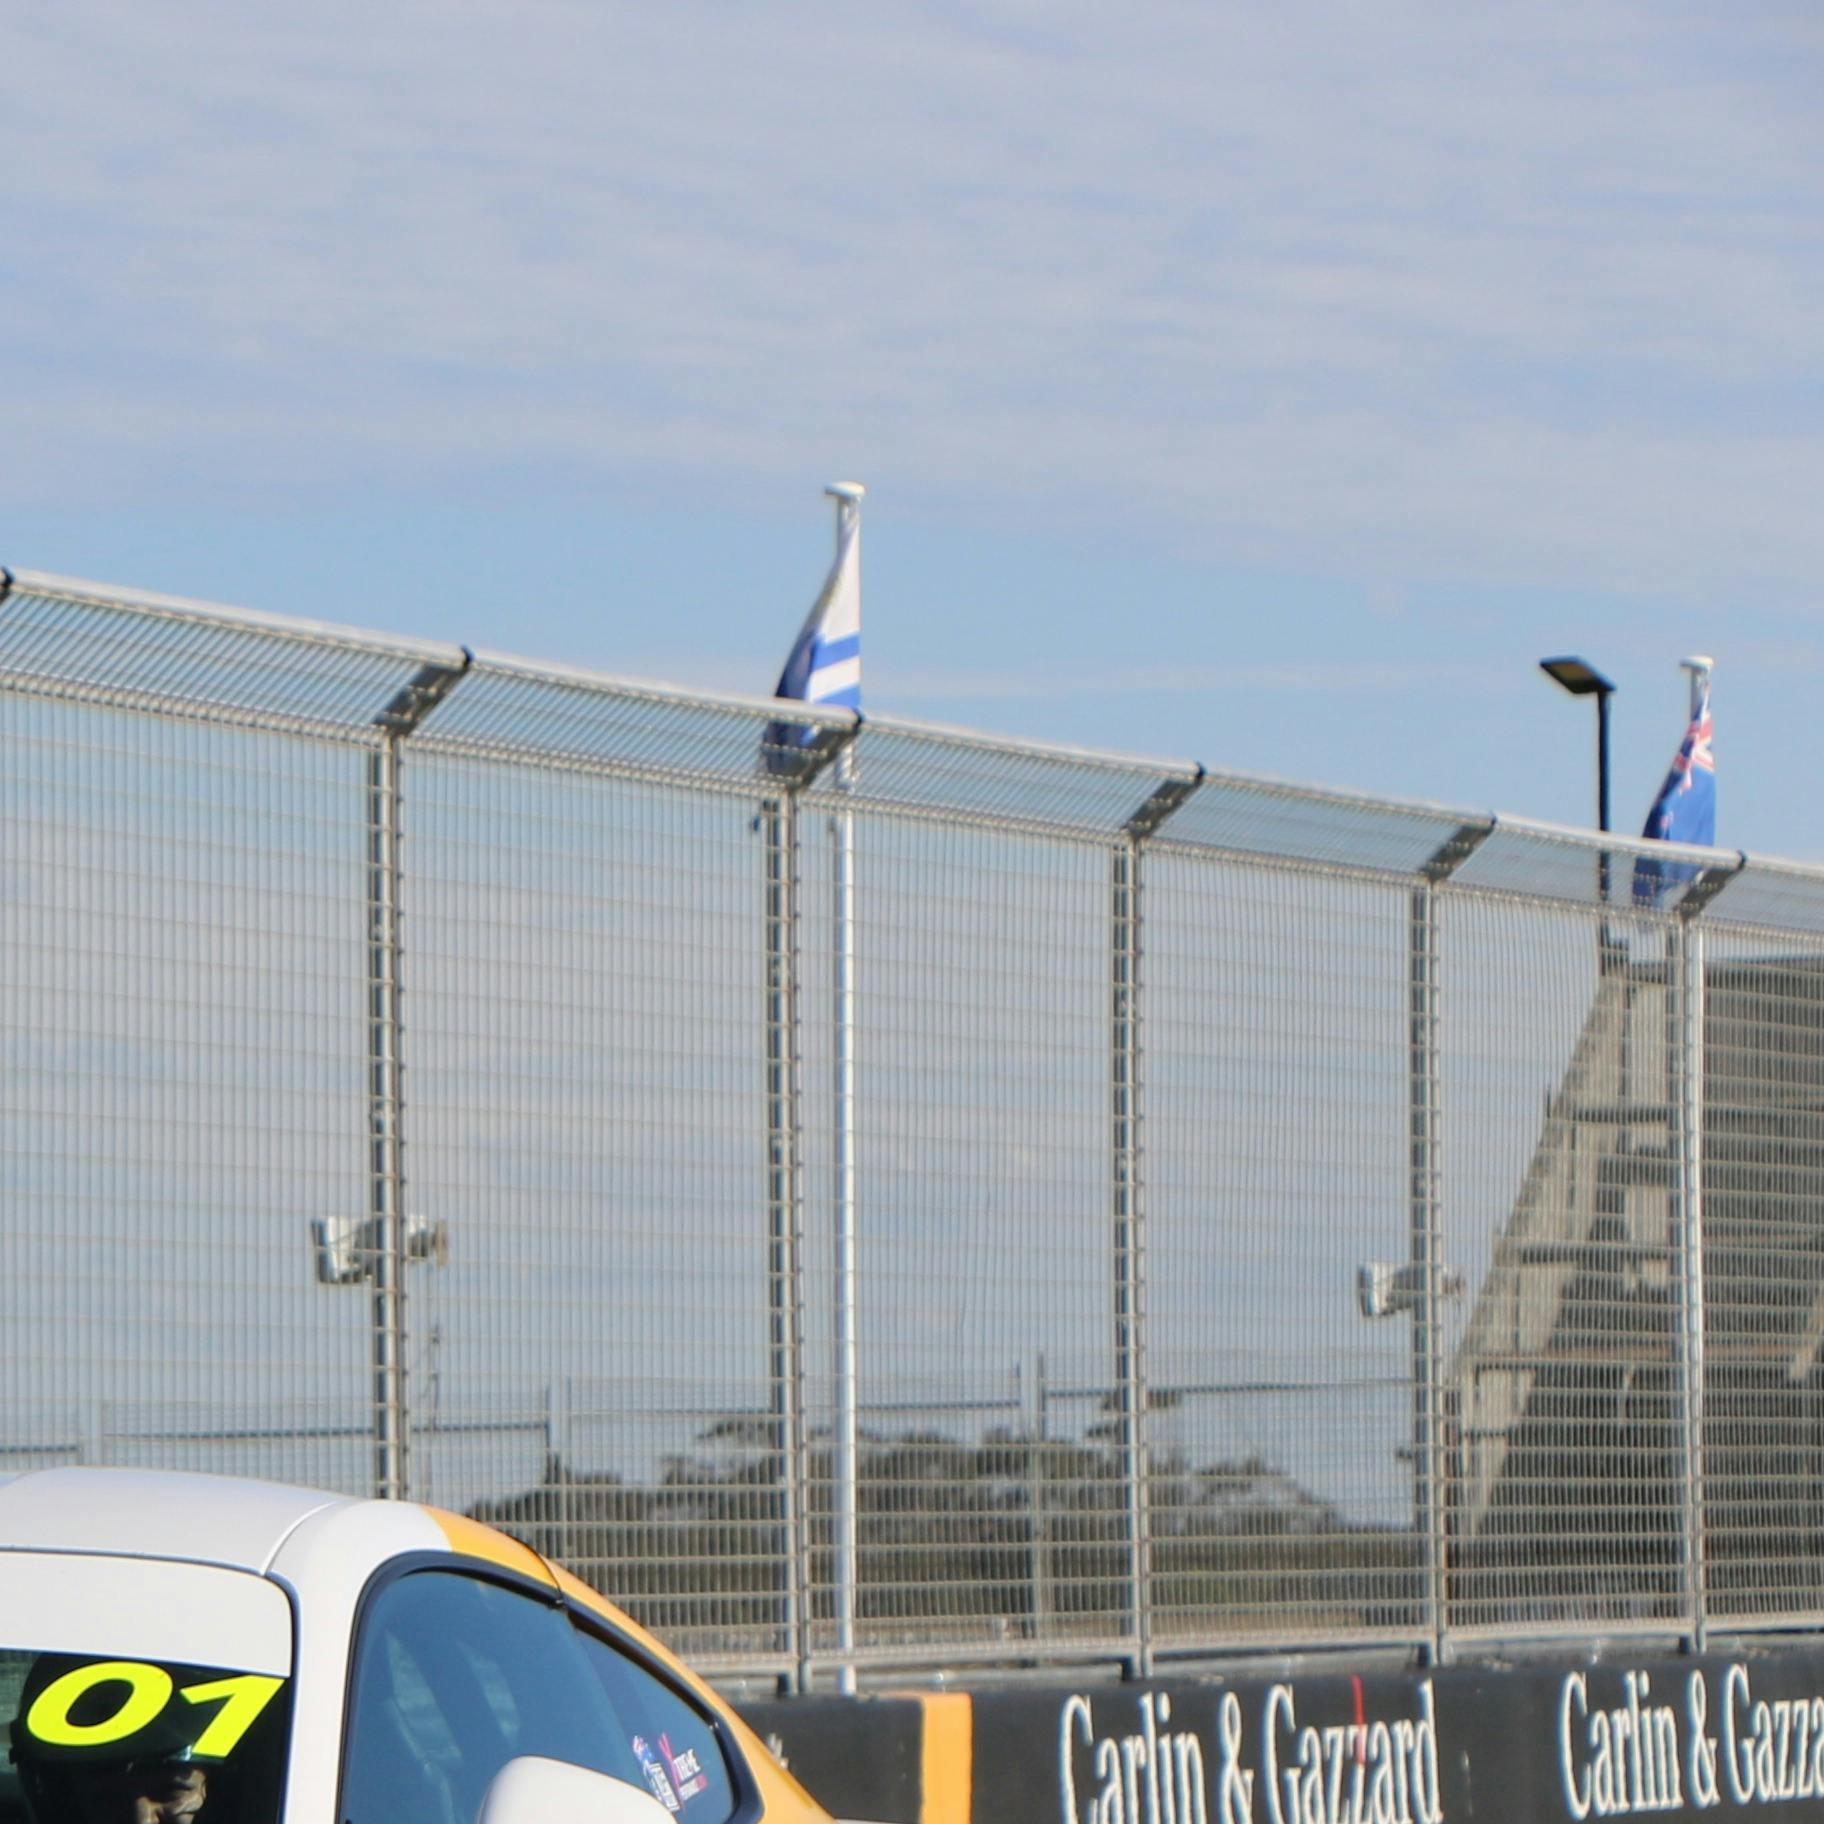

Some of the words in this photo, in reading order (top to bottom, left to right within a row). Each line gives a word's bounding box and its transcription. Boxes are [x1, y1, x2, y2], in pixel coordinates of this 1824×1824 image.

[27, 1661, 286, 1758] 01
[1559, 1668, 1685, 1821] Carlin
[1688, 1668, 1721, 1808] &
